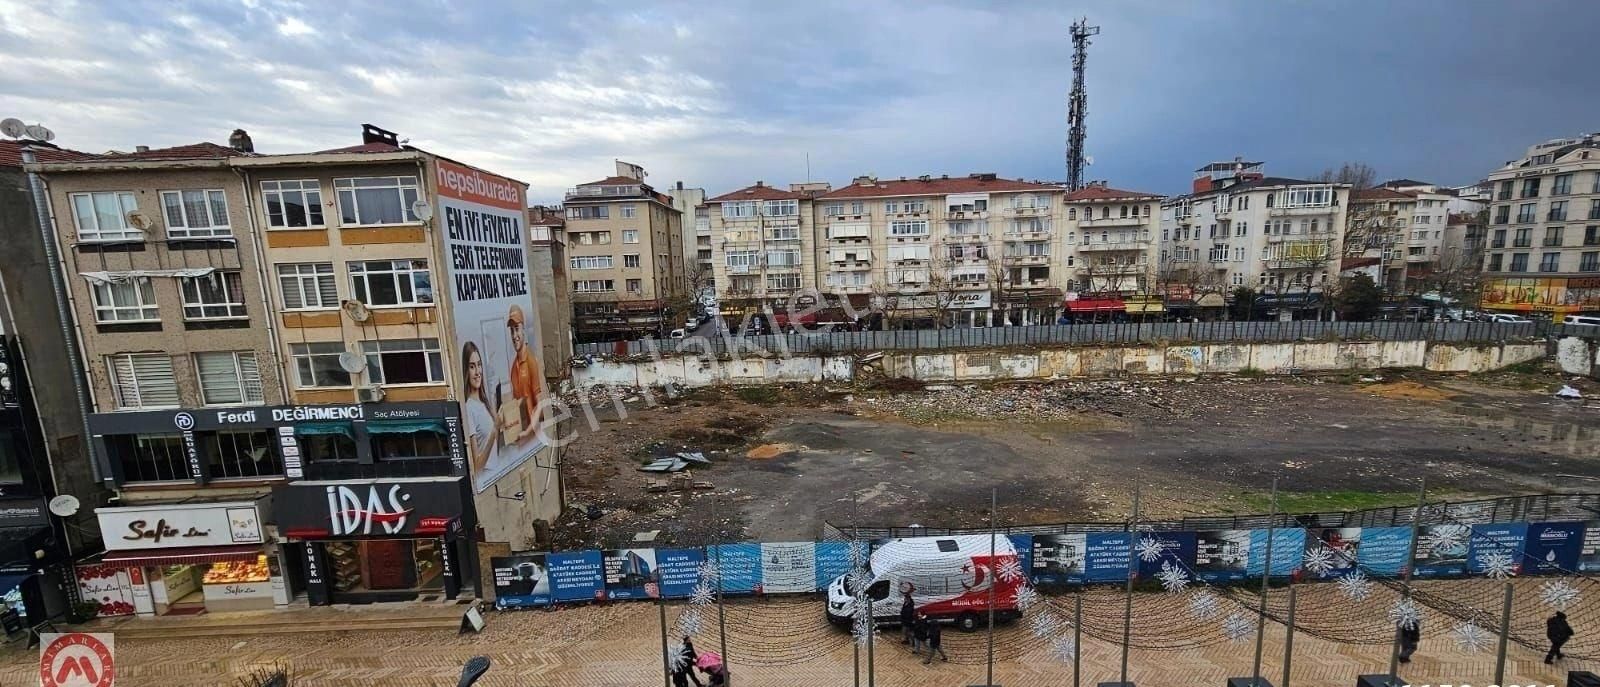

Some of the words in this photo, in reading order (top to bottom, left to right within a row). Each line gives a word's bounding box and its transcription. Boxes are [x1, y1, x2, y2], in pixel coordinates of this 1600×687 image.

[436, 161, 518, 203] hepsiburada
[445, 206, 465, 240] EN
[464, 209, 481, 242] İYİ
[481, 213, 521, 244] FİYATLA
[450, 244, 475, 270] ESKİ
[474, 246, 524, 270] TELEFONUNU
[455, 273, 500, 301] KAPINDA
[500, 272, 527, 298] YENİLE
[217, 410, 257, 424] Ferdi
[271, 404, 364, 422] DEĞİRMENCİ
[374, 410, 388, 418] Saç
[390, 408, 420, 418] Atölyesi
[123, 518, 180, 543] Safir
[305, 540, 317, 577] KONAK
[441, 543, 449, 571] KONAK
